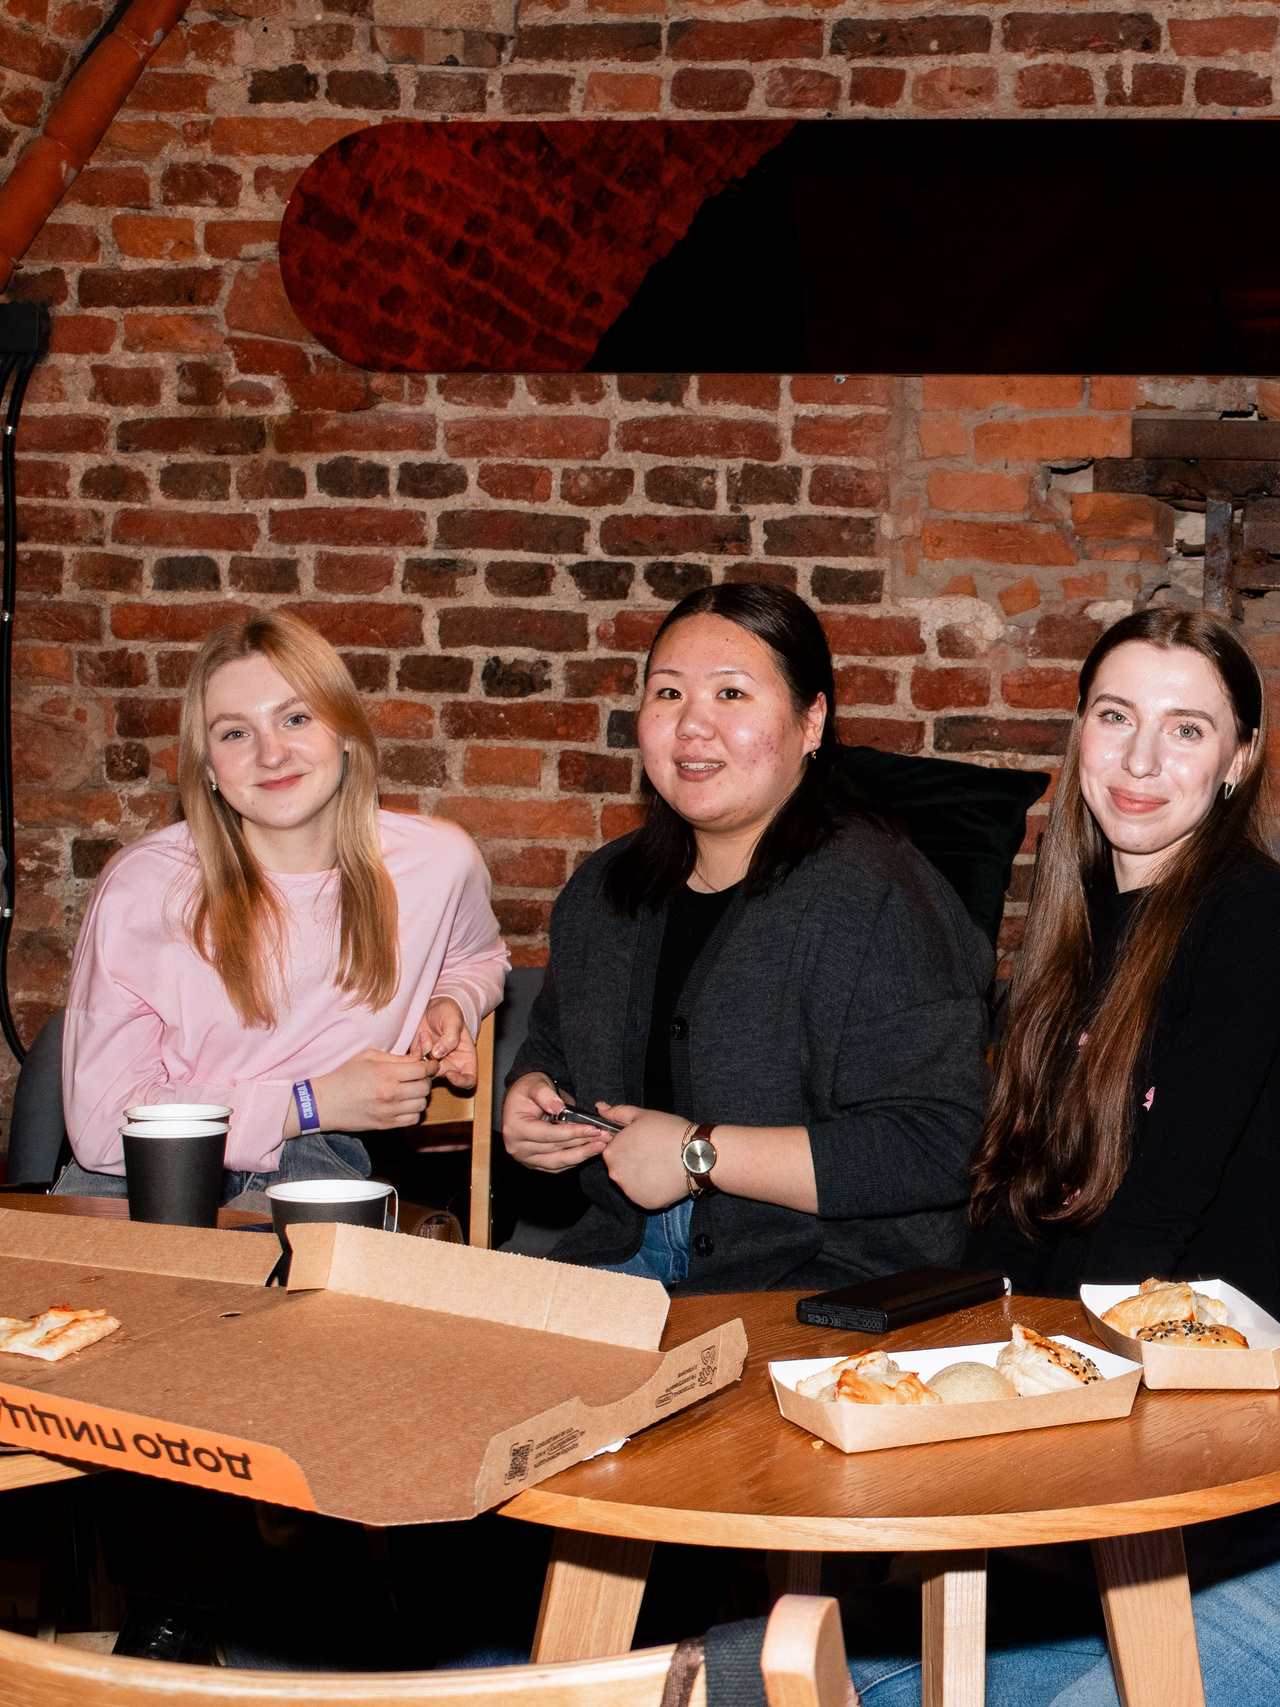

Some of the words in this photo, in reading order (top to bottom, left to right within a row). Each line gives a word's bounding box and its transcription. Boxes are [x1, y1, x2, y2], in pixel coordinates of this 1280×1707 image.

[297, 1085, 313, 1119] СХОДКА
[862, 1320, 883, 1330] 10000
[0, 1396, 128, 1453] ПИЦЦ
[132, 1432, 252, 1481] ДОДО
